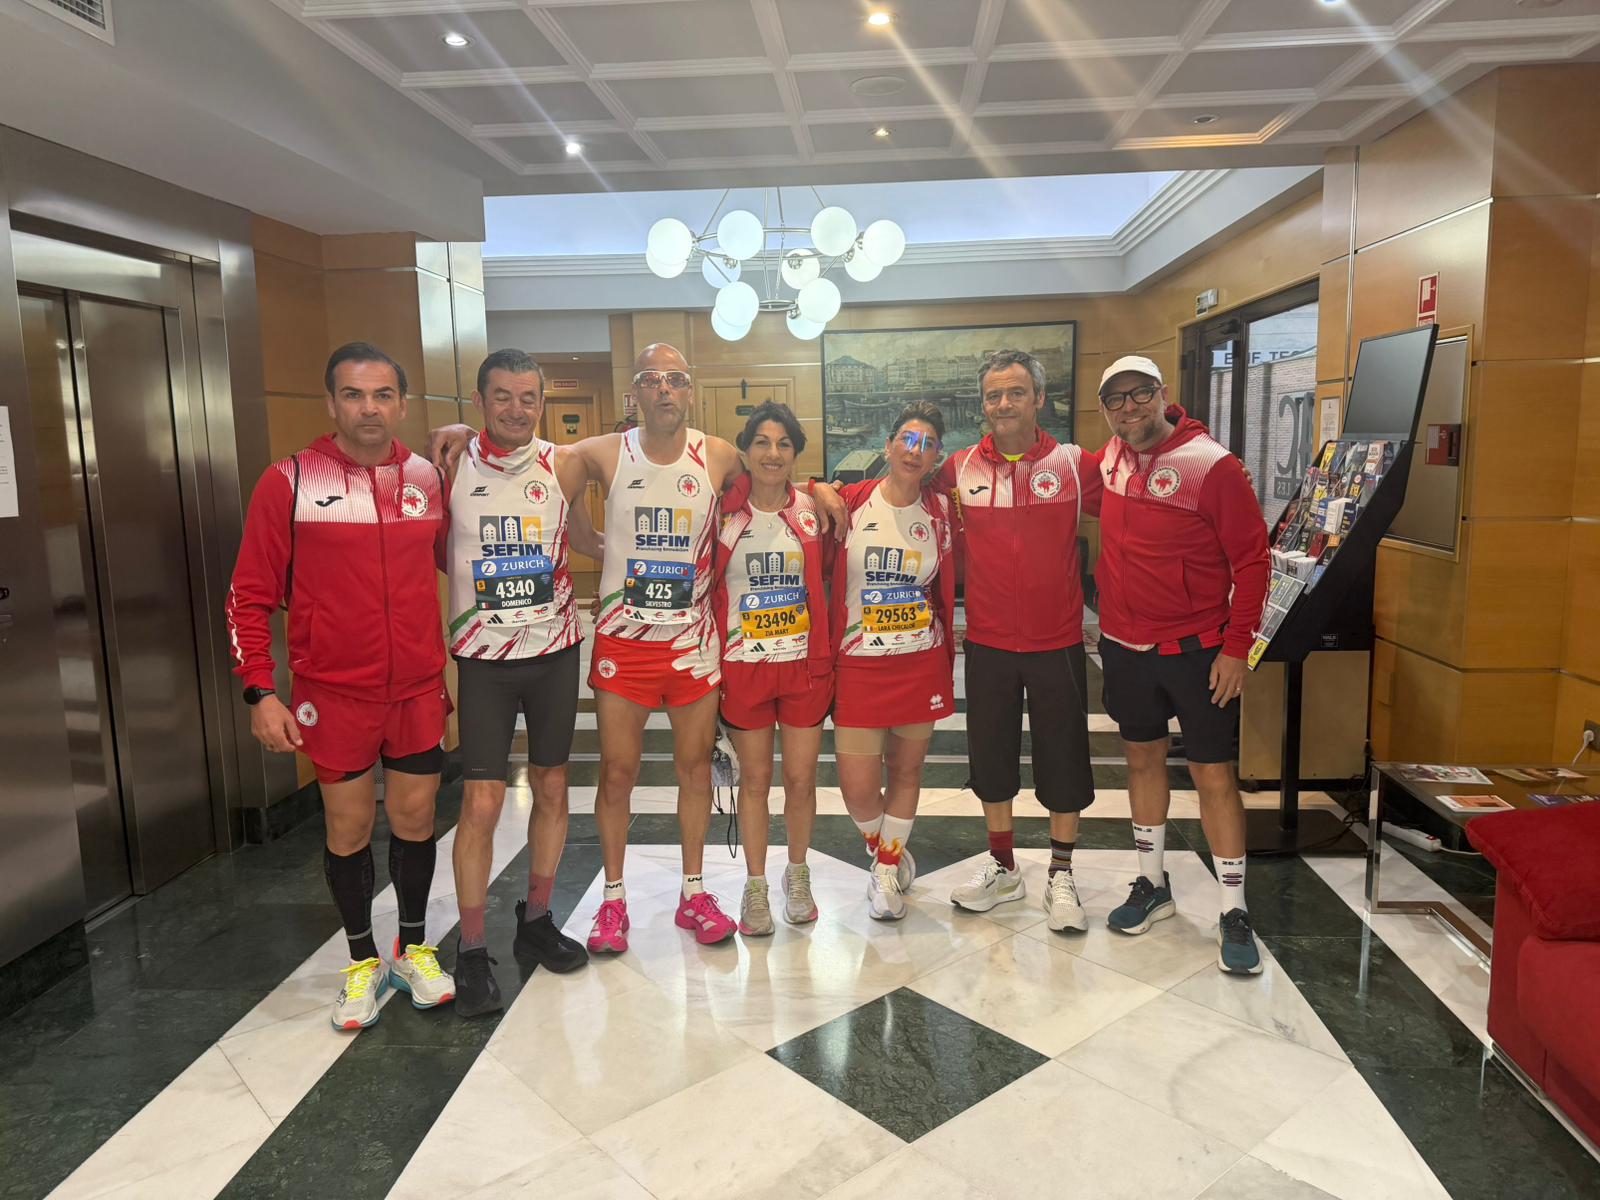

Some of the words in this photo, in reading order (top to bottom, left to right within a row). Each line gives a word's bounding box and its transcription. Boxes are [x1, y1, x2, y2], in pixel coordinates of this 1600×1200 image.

[635, 534, 690, 547] SEFIM
[481, 543, 543, 557] SEFIM
[501, 559, 544, 571] ZURICH
[748, 574, 800, 587] SEFIM
[865, 571, 917, 583] SEFIM
[495, 579, 535, 599] 4340
[645, 583, 672, 600] 425
[501, 598, 532, 608] DOMENICO
[645, 600, 672, 608] SILVESTRO
[763, 592, 799, 604] ZURICH
[754, 611, 796, 630] 23496
[876, 606, 917, 624] 29563
